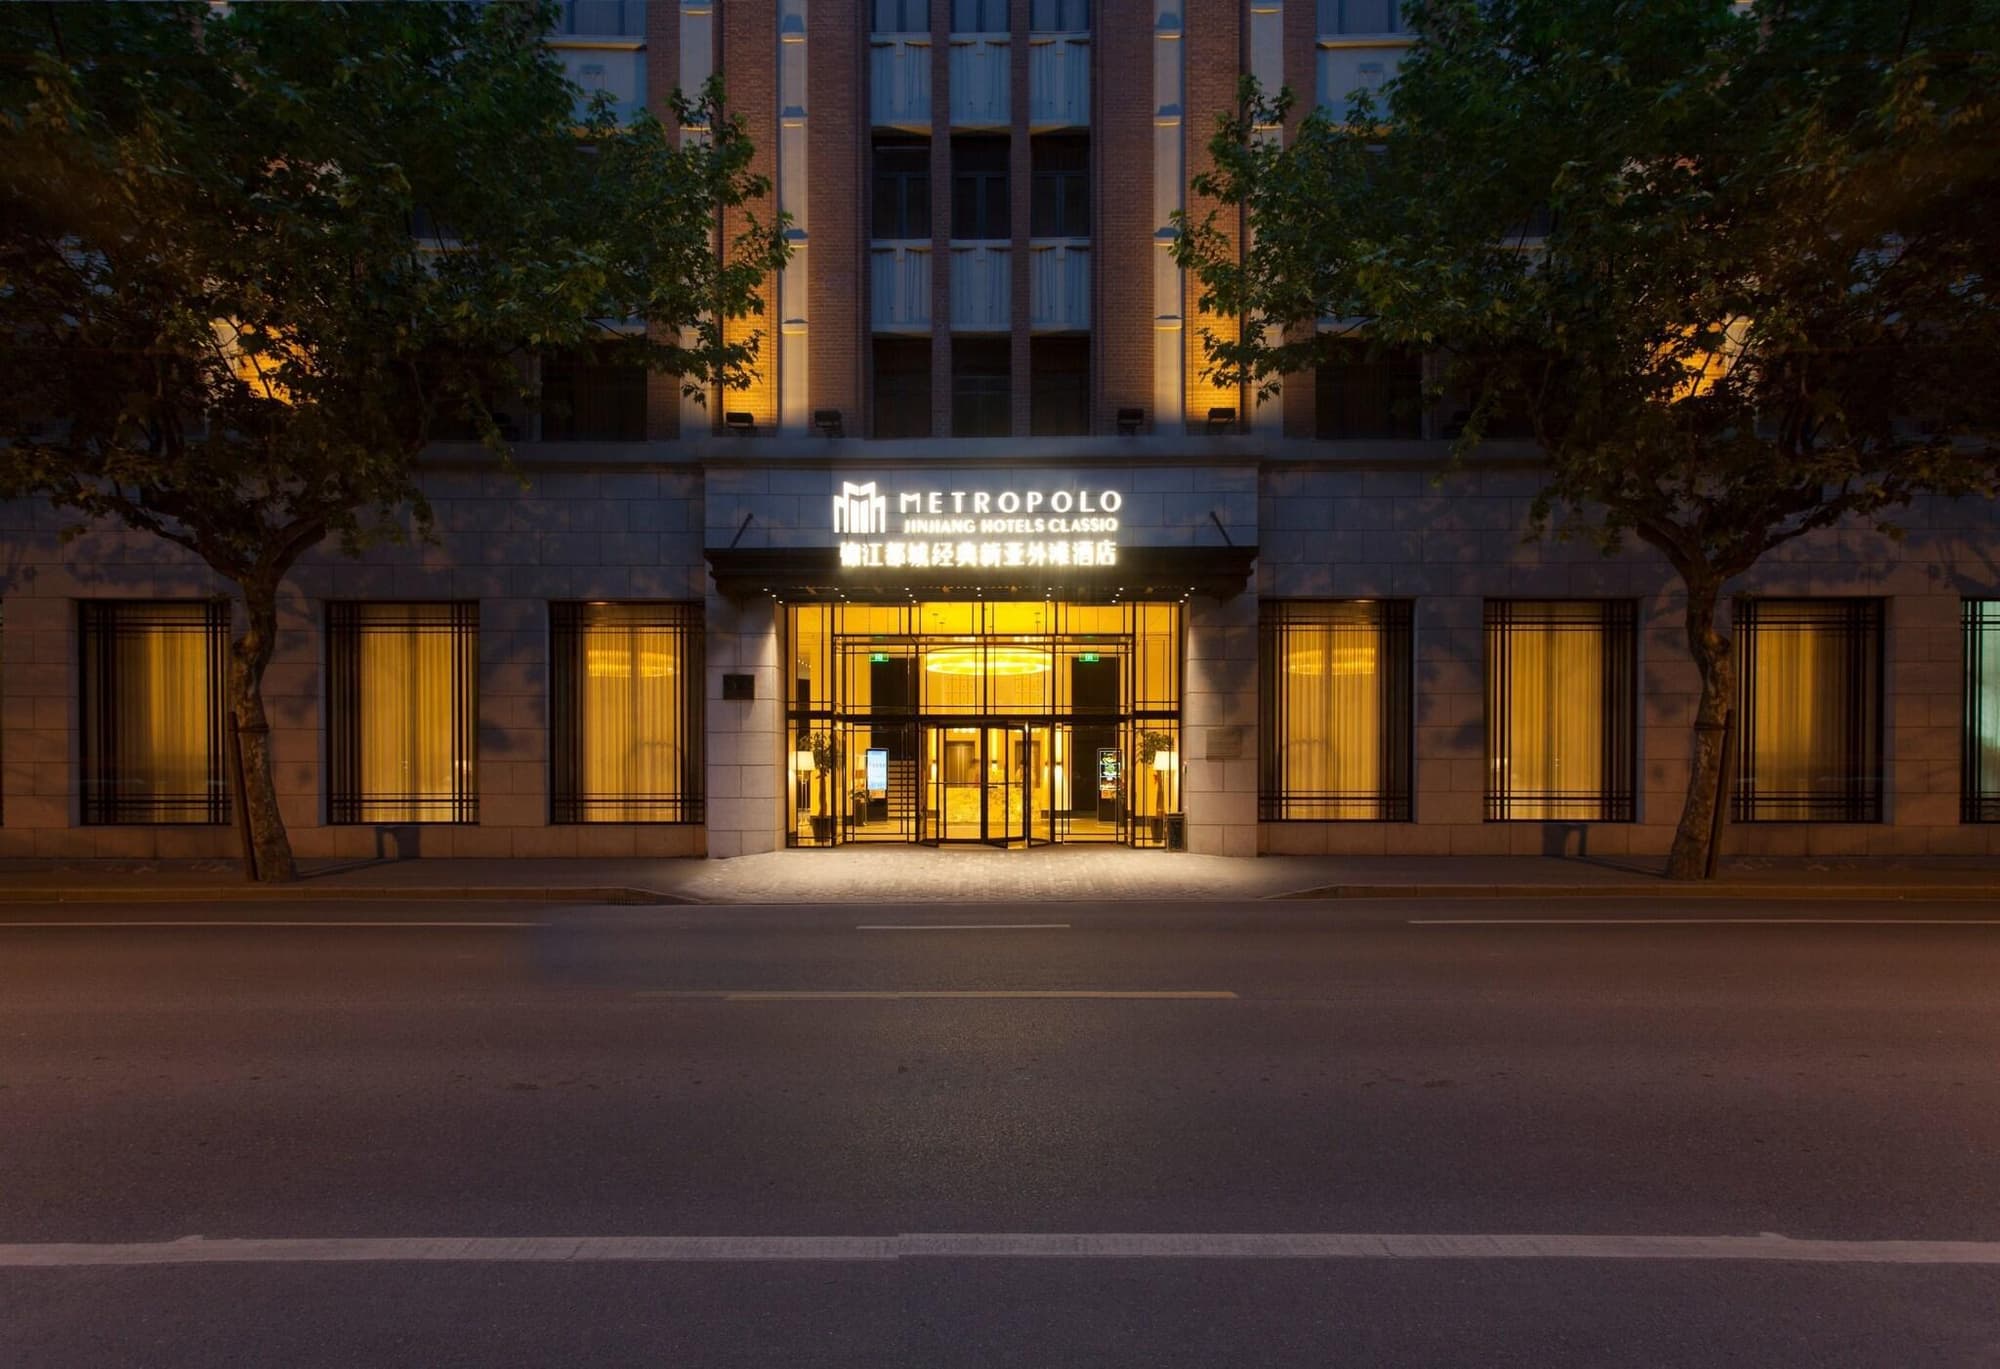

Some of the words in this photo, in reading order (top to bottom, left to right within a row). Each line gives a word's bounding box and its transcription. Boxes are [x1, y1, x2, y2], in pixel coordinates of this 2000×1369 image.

[899, 490, 1122, 514] METROPOLO
[904, 519, 976, 533] JINJIANG
[980, 518, 1044, 533] HOTELS
